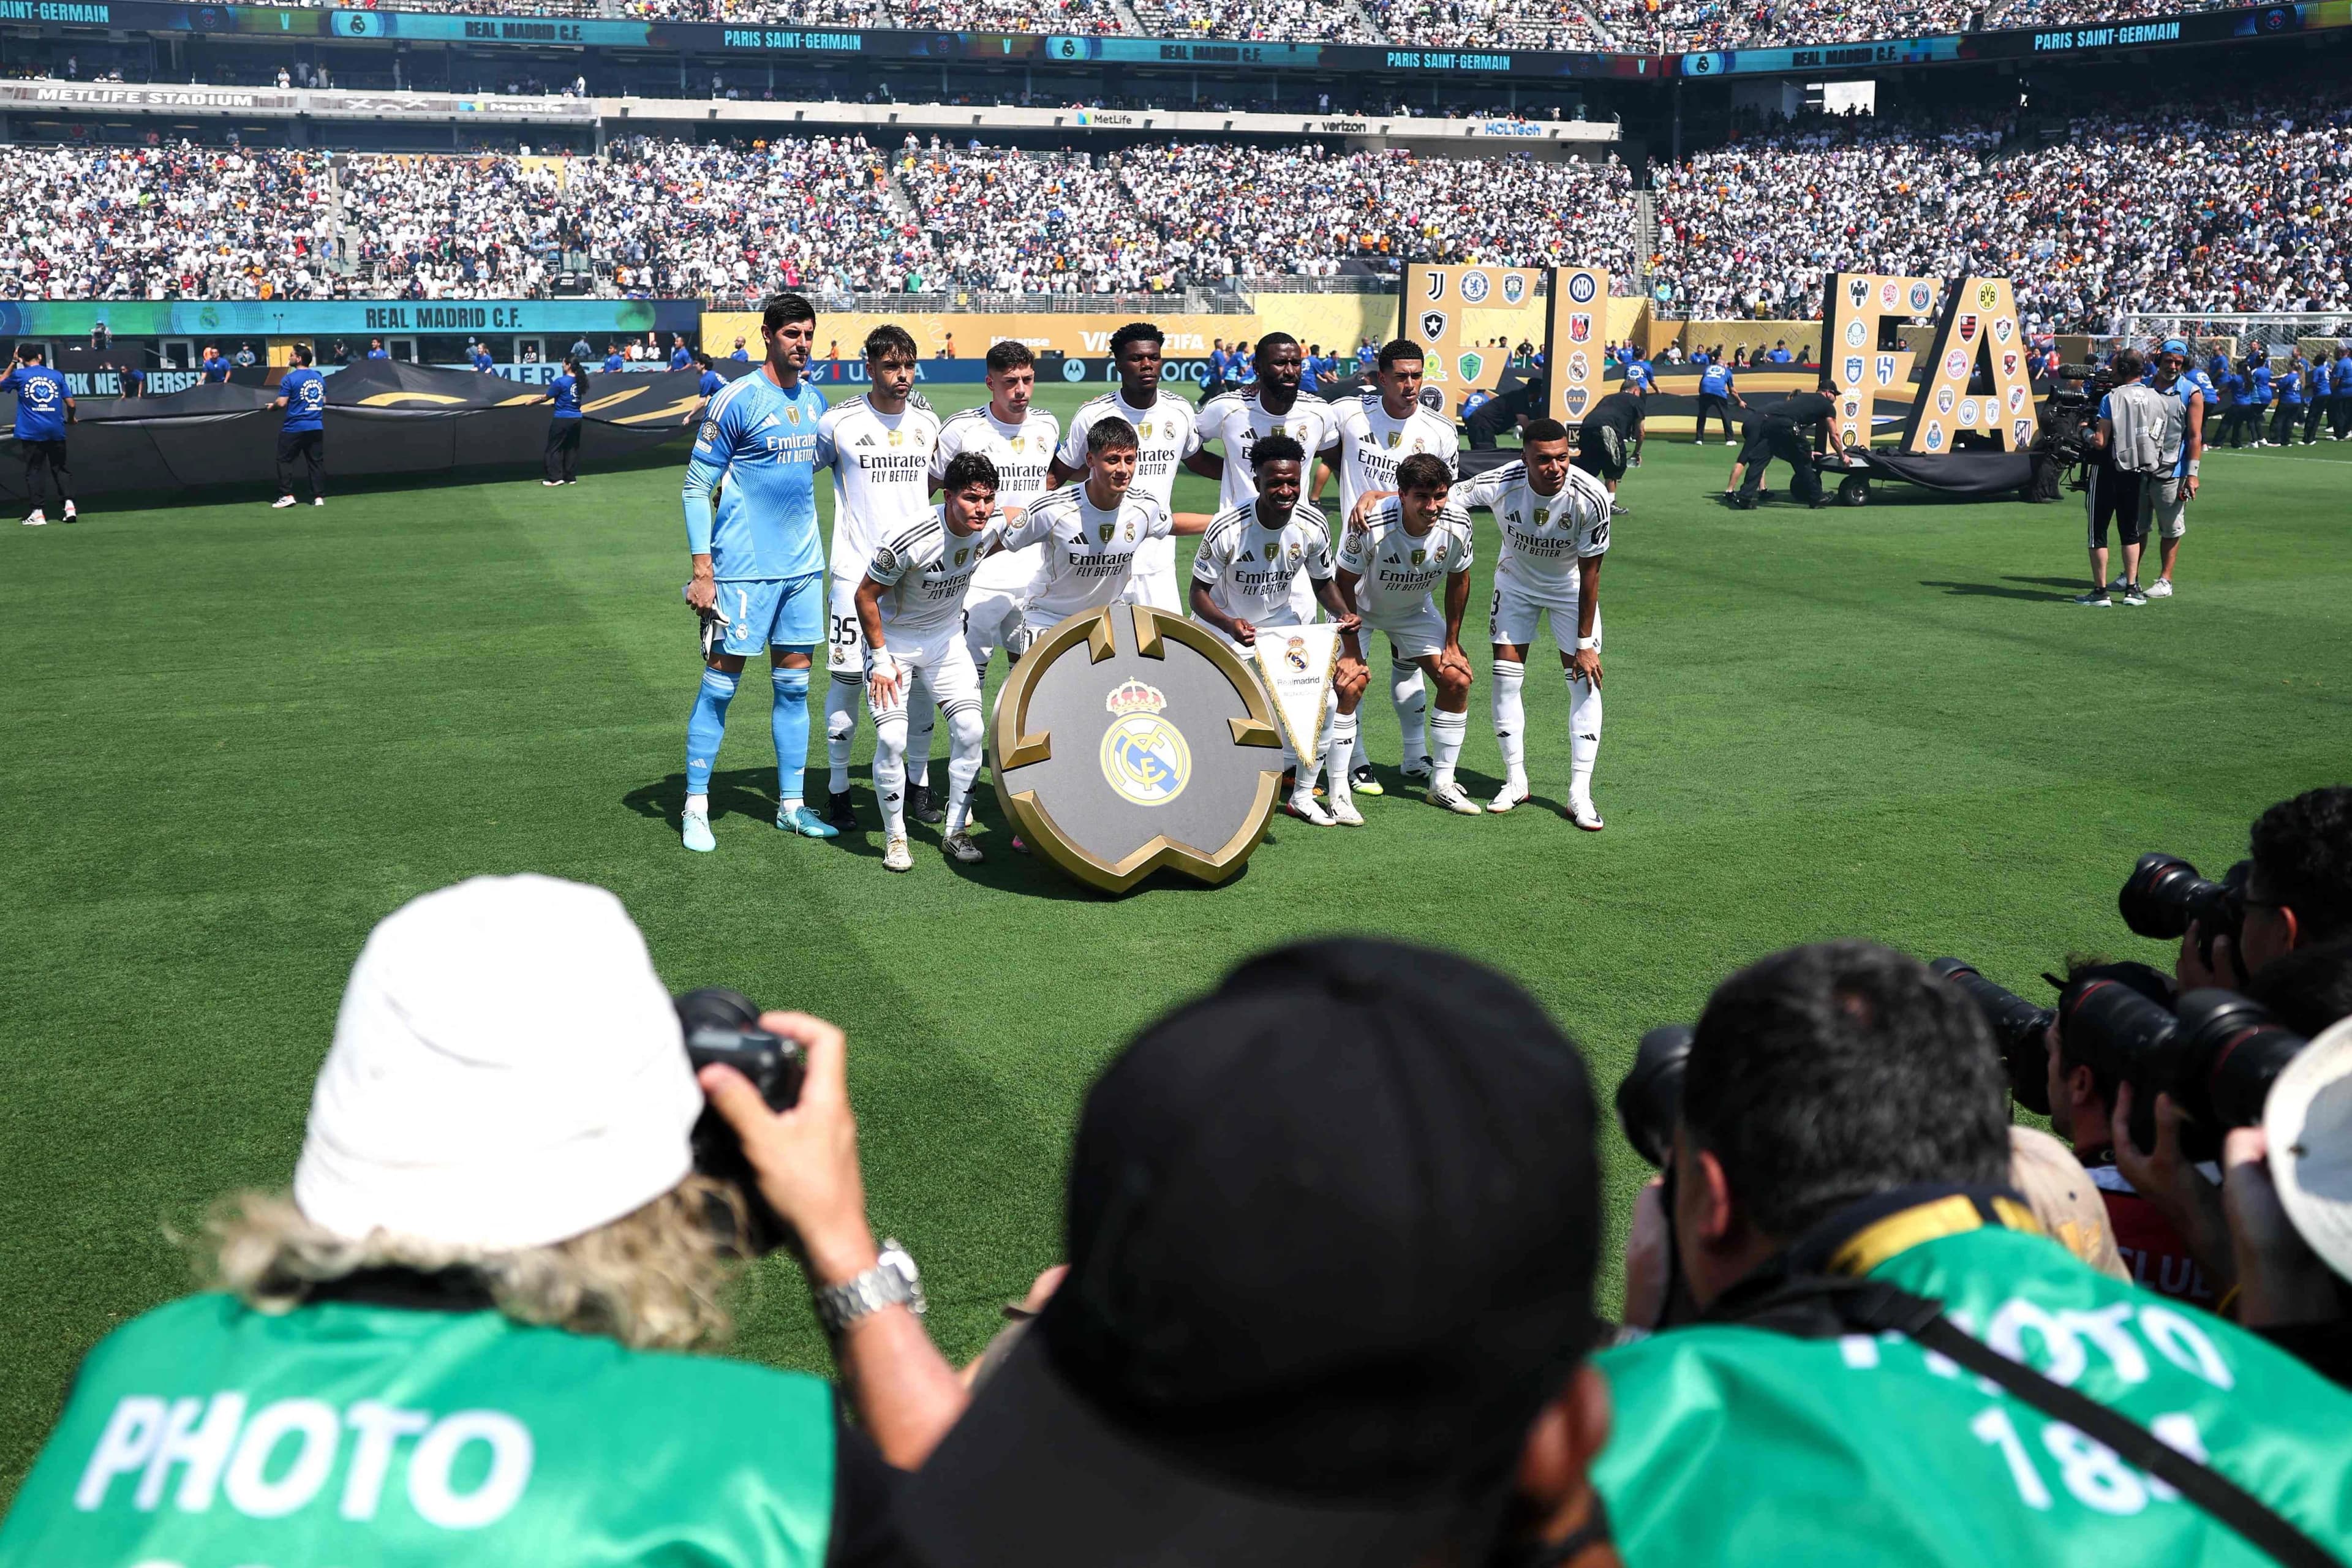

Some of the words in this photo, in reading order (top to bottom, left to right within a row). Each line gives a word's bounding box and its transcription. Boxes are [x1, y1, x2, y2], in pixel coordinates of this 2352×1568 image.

[280, 13, 289, 29] V
[466, 21, 498, 37] REAL
[502, 23, 556, 39] MADRID
[560, 25, 582, 40] C.F.
[2035, 32, 2073, 50] PARIS
[2078, 22, 2180, 46] SAINT-GERMAIN
[725, 30, 760, 47] PARIS
[766, 32, 861, 50] SAINT-GERMAIN
[1003, 39, 1011, 53] V
[1160, 45, 1189, 59] REAL
[1193, 46, 1238, 61] MADRID
[1793, 51, 1822, 66] REAL
[1826, 48, 1872, 65] MADRID
[1387, 52, 1420, 67] PARIS
[1424, 53, 1510, 70] SAINT-GERMAIN
[1638, 59, 1645, 74] V
[37, 88, 140, 103] METLIFE
[148, 92, 252, 107] STADIUM
[491, 103, 562, 112] MetLife
[1094, 115, 1132, 124] MetLife
[1322, 121, 1366, 133] verizon
[1485, 123, 1541, 136] HCLTech
[1980, 285, 1996, 301] BVB
[366, 307, 409, 328] REAL
[417, 308, 485, 328] MADRID
[493, 308, 522, 328] C.F.
[64, 373, 90, 394] RK
[766, 433, 817, 451] Emirate
[777, 450, 792, 464] FLY
[859, 454, 926, 469] Emirates
[1138, 448, 1175, 462] irates
[1358, 448, 1401, 471] Emira
[872, 470, 886, 483] FLY
[889, 470, 918, 482] BETTER
[996, 463, 1047, 478] mirates
[1139, 464, 1167, 475] BETTER
[1364, 467, 1378, 479] FLY
[999, 480, 1010, 491] LY
[1013, 480, 1039, 491] BETTER
[1507, 524, 1571, 548] Emirates
[1514, 540, 1528, 552] FLY
[1529, 547, 1561, 557] BETTER
[1069, 551, 1135, 565] Emirates
[1076, 567, 1093, 577] FLY
[1094, 565, 1125, 577] BETTER
[1379, 568, 1443, 583] Emirates
[1243, 586, 1259, 596] FLY
[1260, 582, 1287, 596] BETTER
[1385, 582, 1401, 591] FLY
[1401, 580, 1431, 592] BETTER
[928, 589, 944, 600] FLY
[737, 589, 748, 619] 1
[830, 615, 857, 646] 35
[74, 1392, 533, 1529] PHOTO
